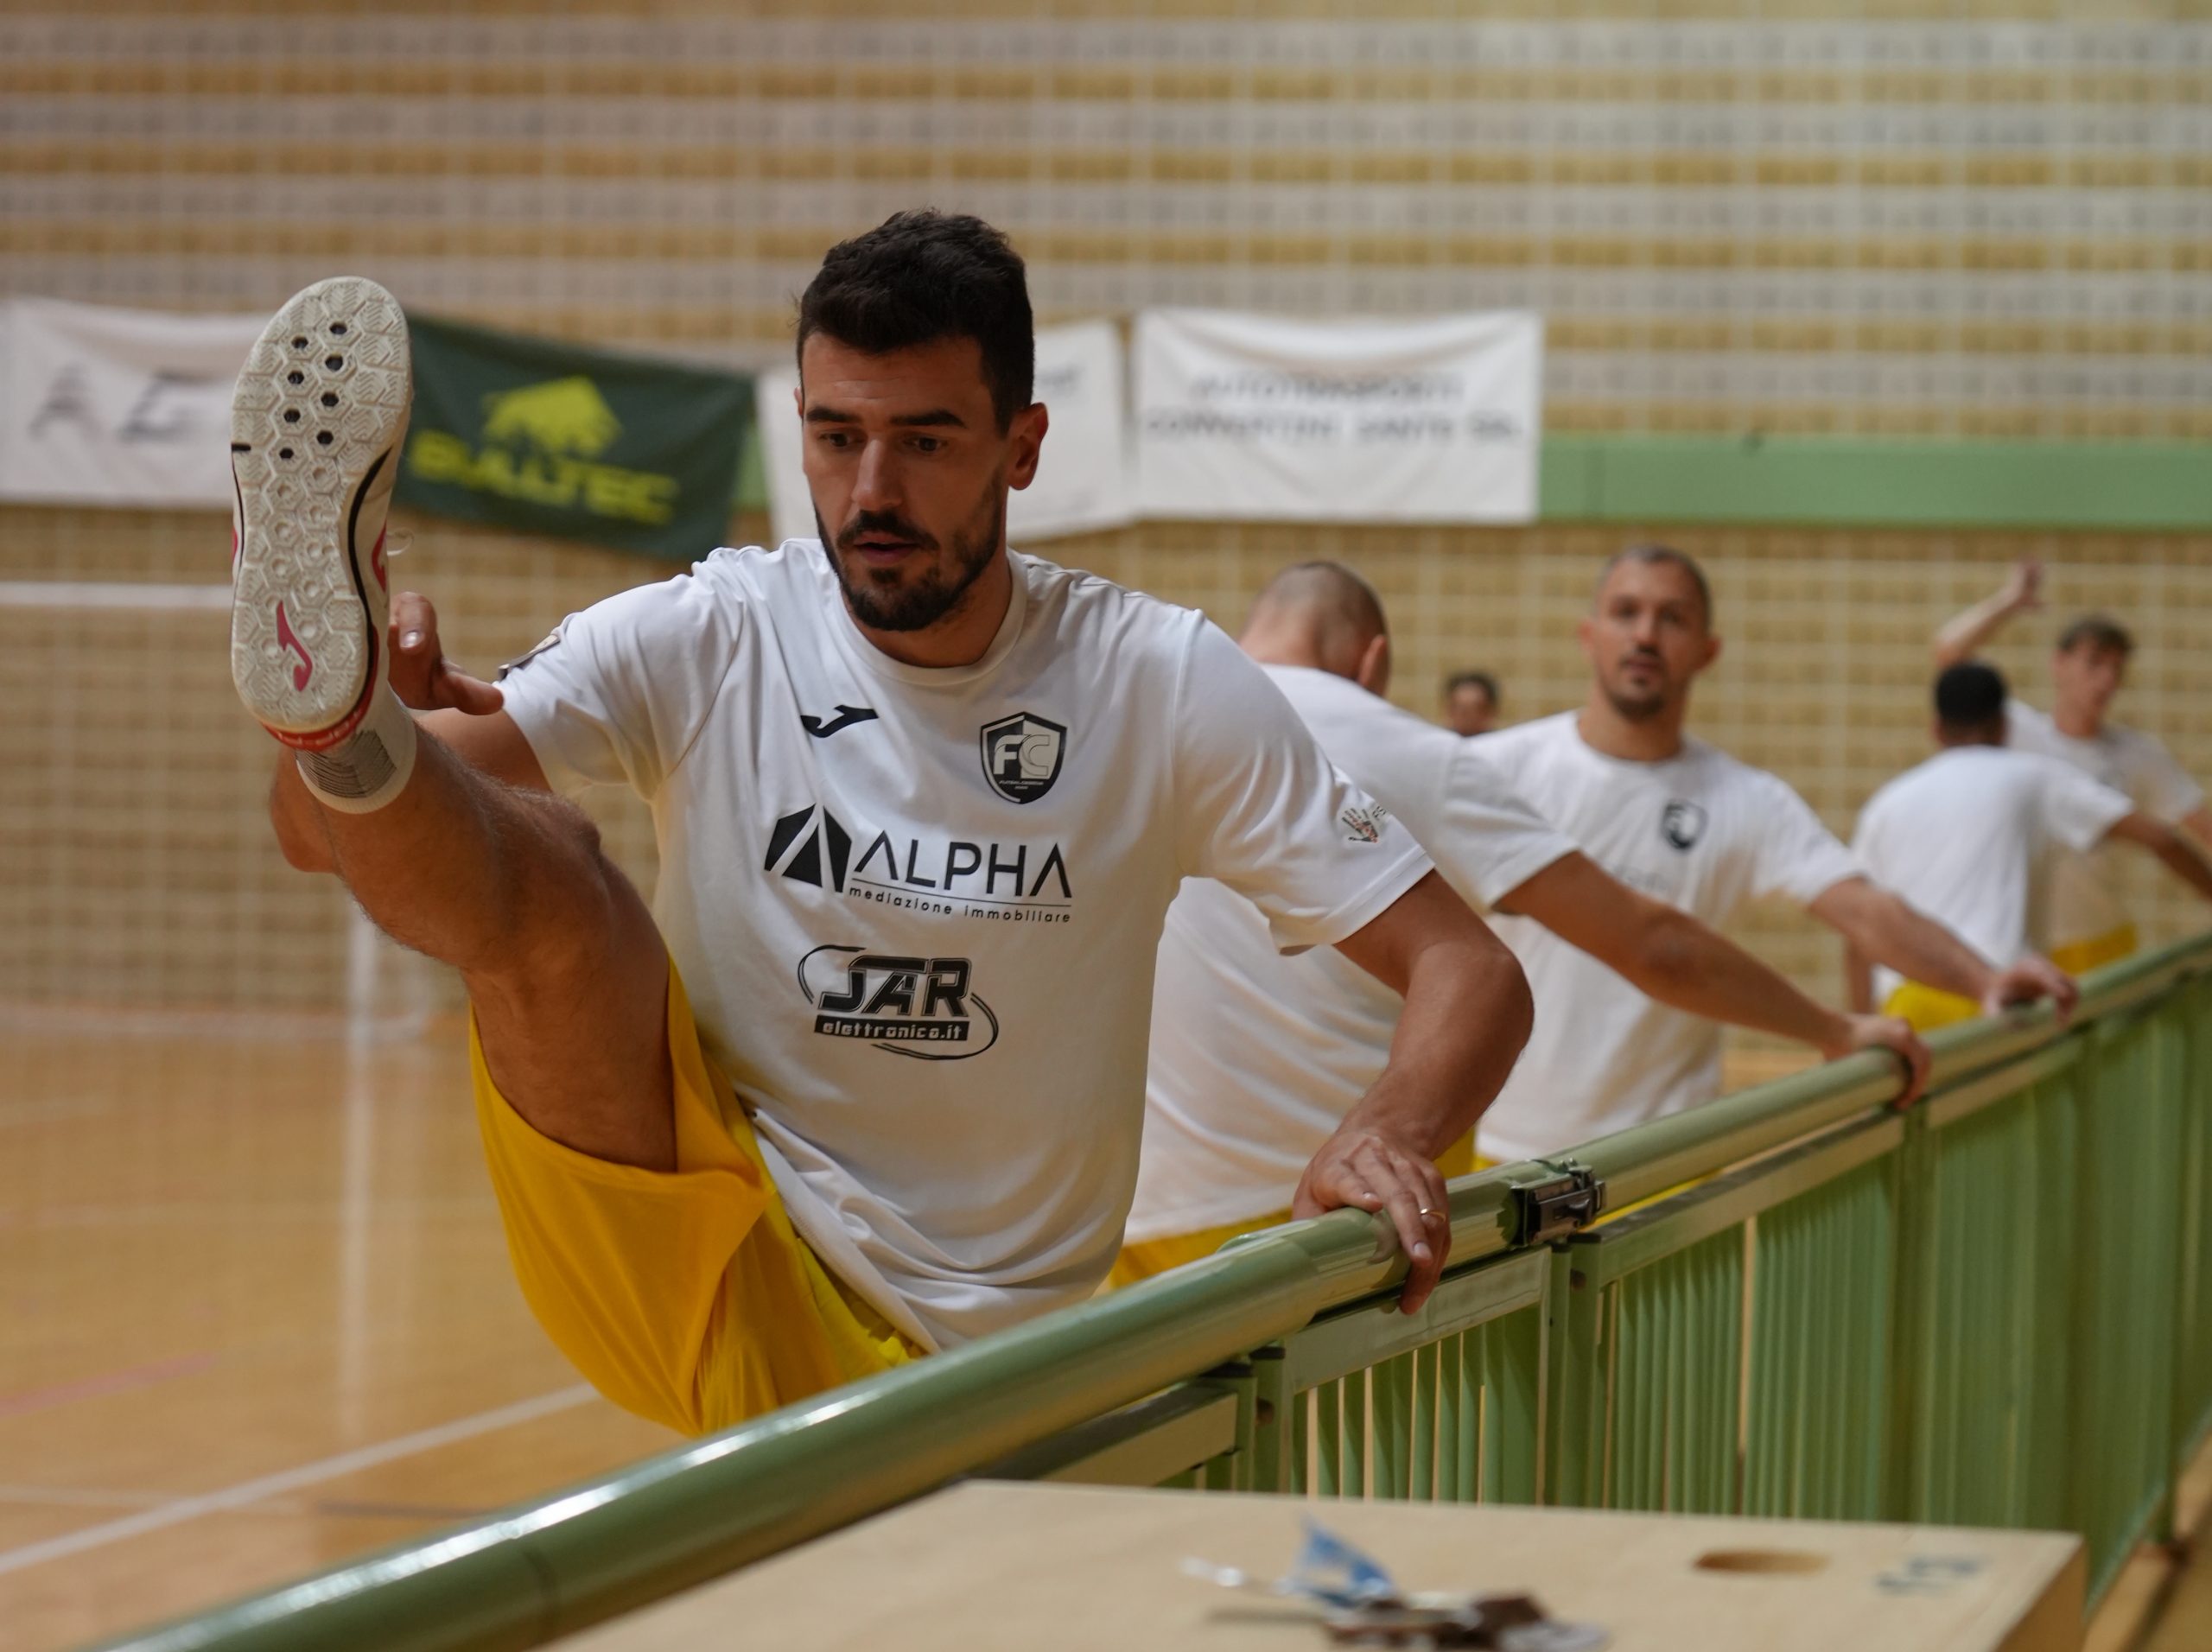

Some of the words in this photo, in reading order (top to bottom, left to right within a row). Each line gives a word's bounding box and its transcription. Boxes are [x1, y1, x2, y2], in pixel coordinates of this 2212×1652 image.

[854, 829, 1072, 899] ALPHA
[849, 886, 952, 915] mediazione
[964, 905, 1071, 923] immobiliare
[822, 1020, 963, 1040] elettronica.it
